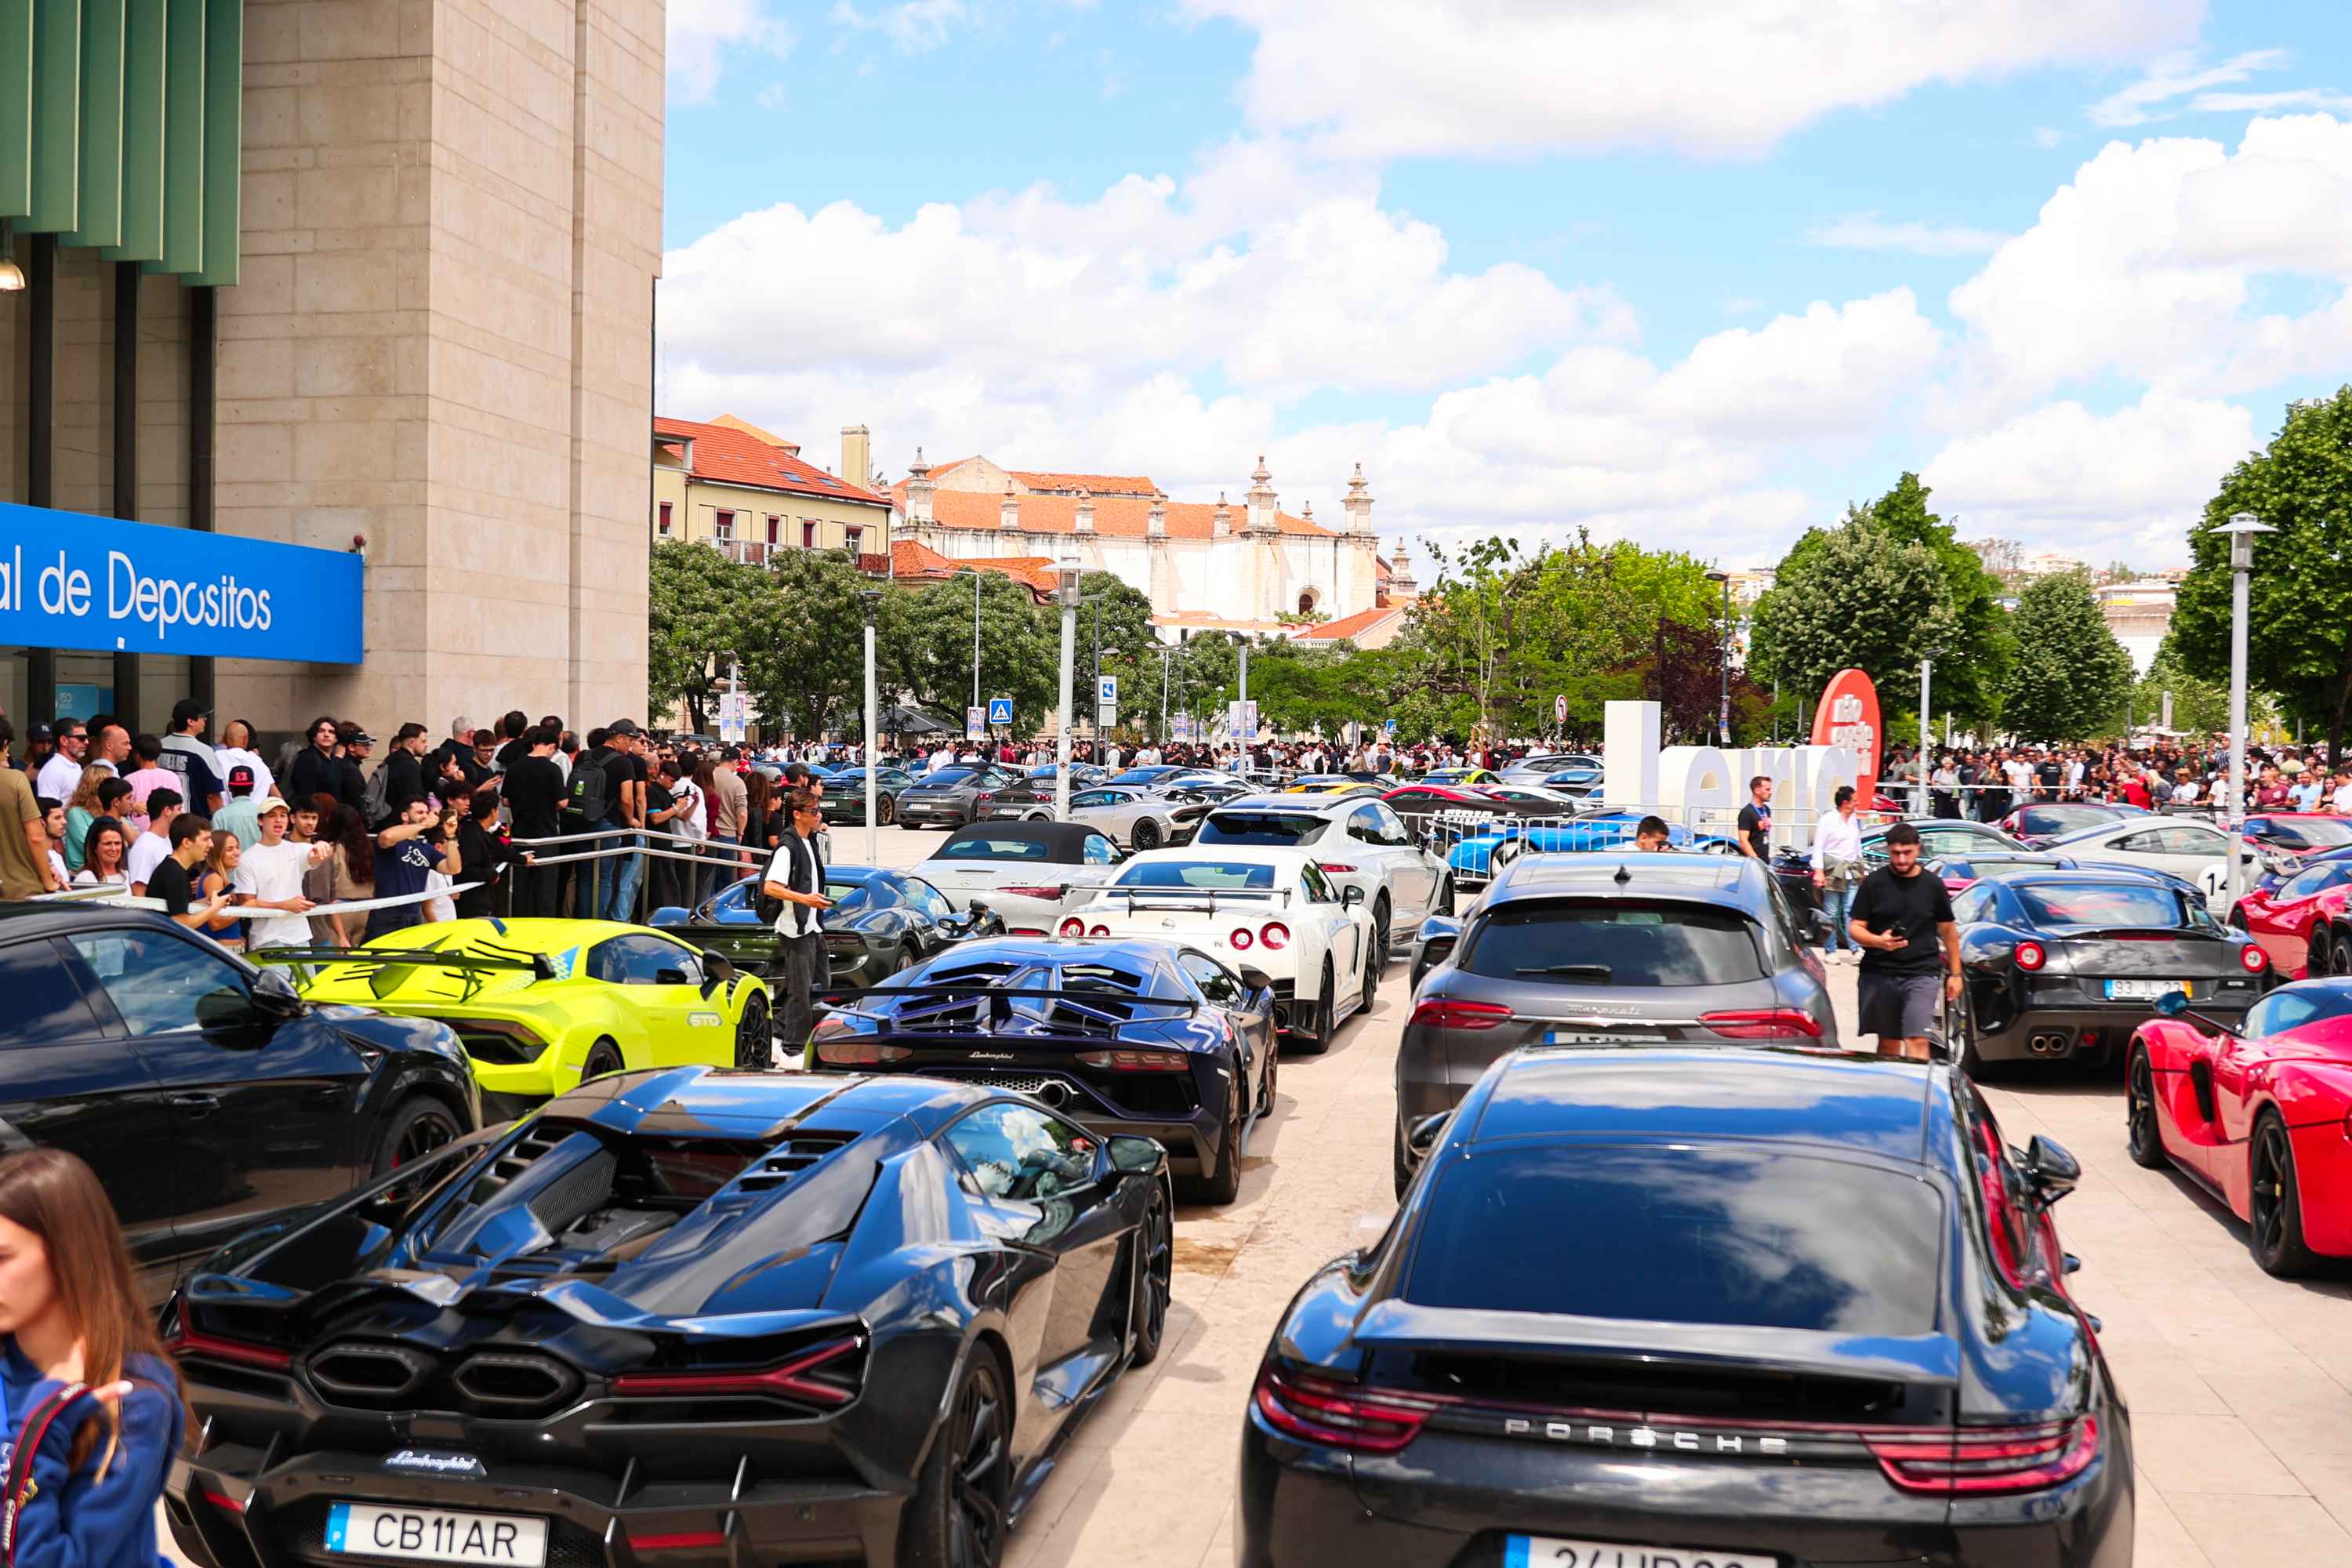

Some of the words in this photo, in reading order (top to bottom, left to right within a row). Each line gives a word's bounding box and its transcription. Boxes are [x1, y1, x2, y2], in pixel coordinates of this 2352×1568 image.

[38, 550, 92, 616] de
[1504, 1417, 1788, 1454] PORSCHE
[386, 1450, 477, 1471] Lamborghini
